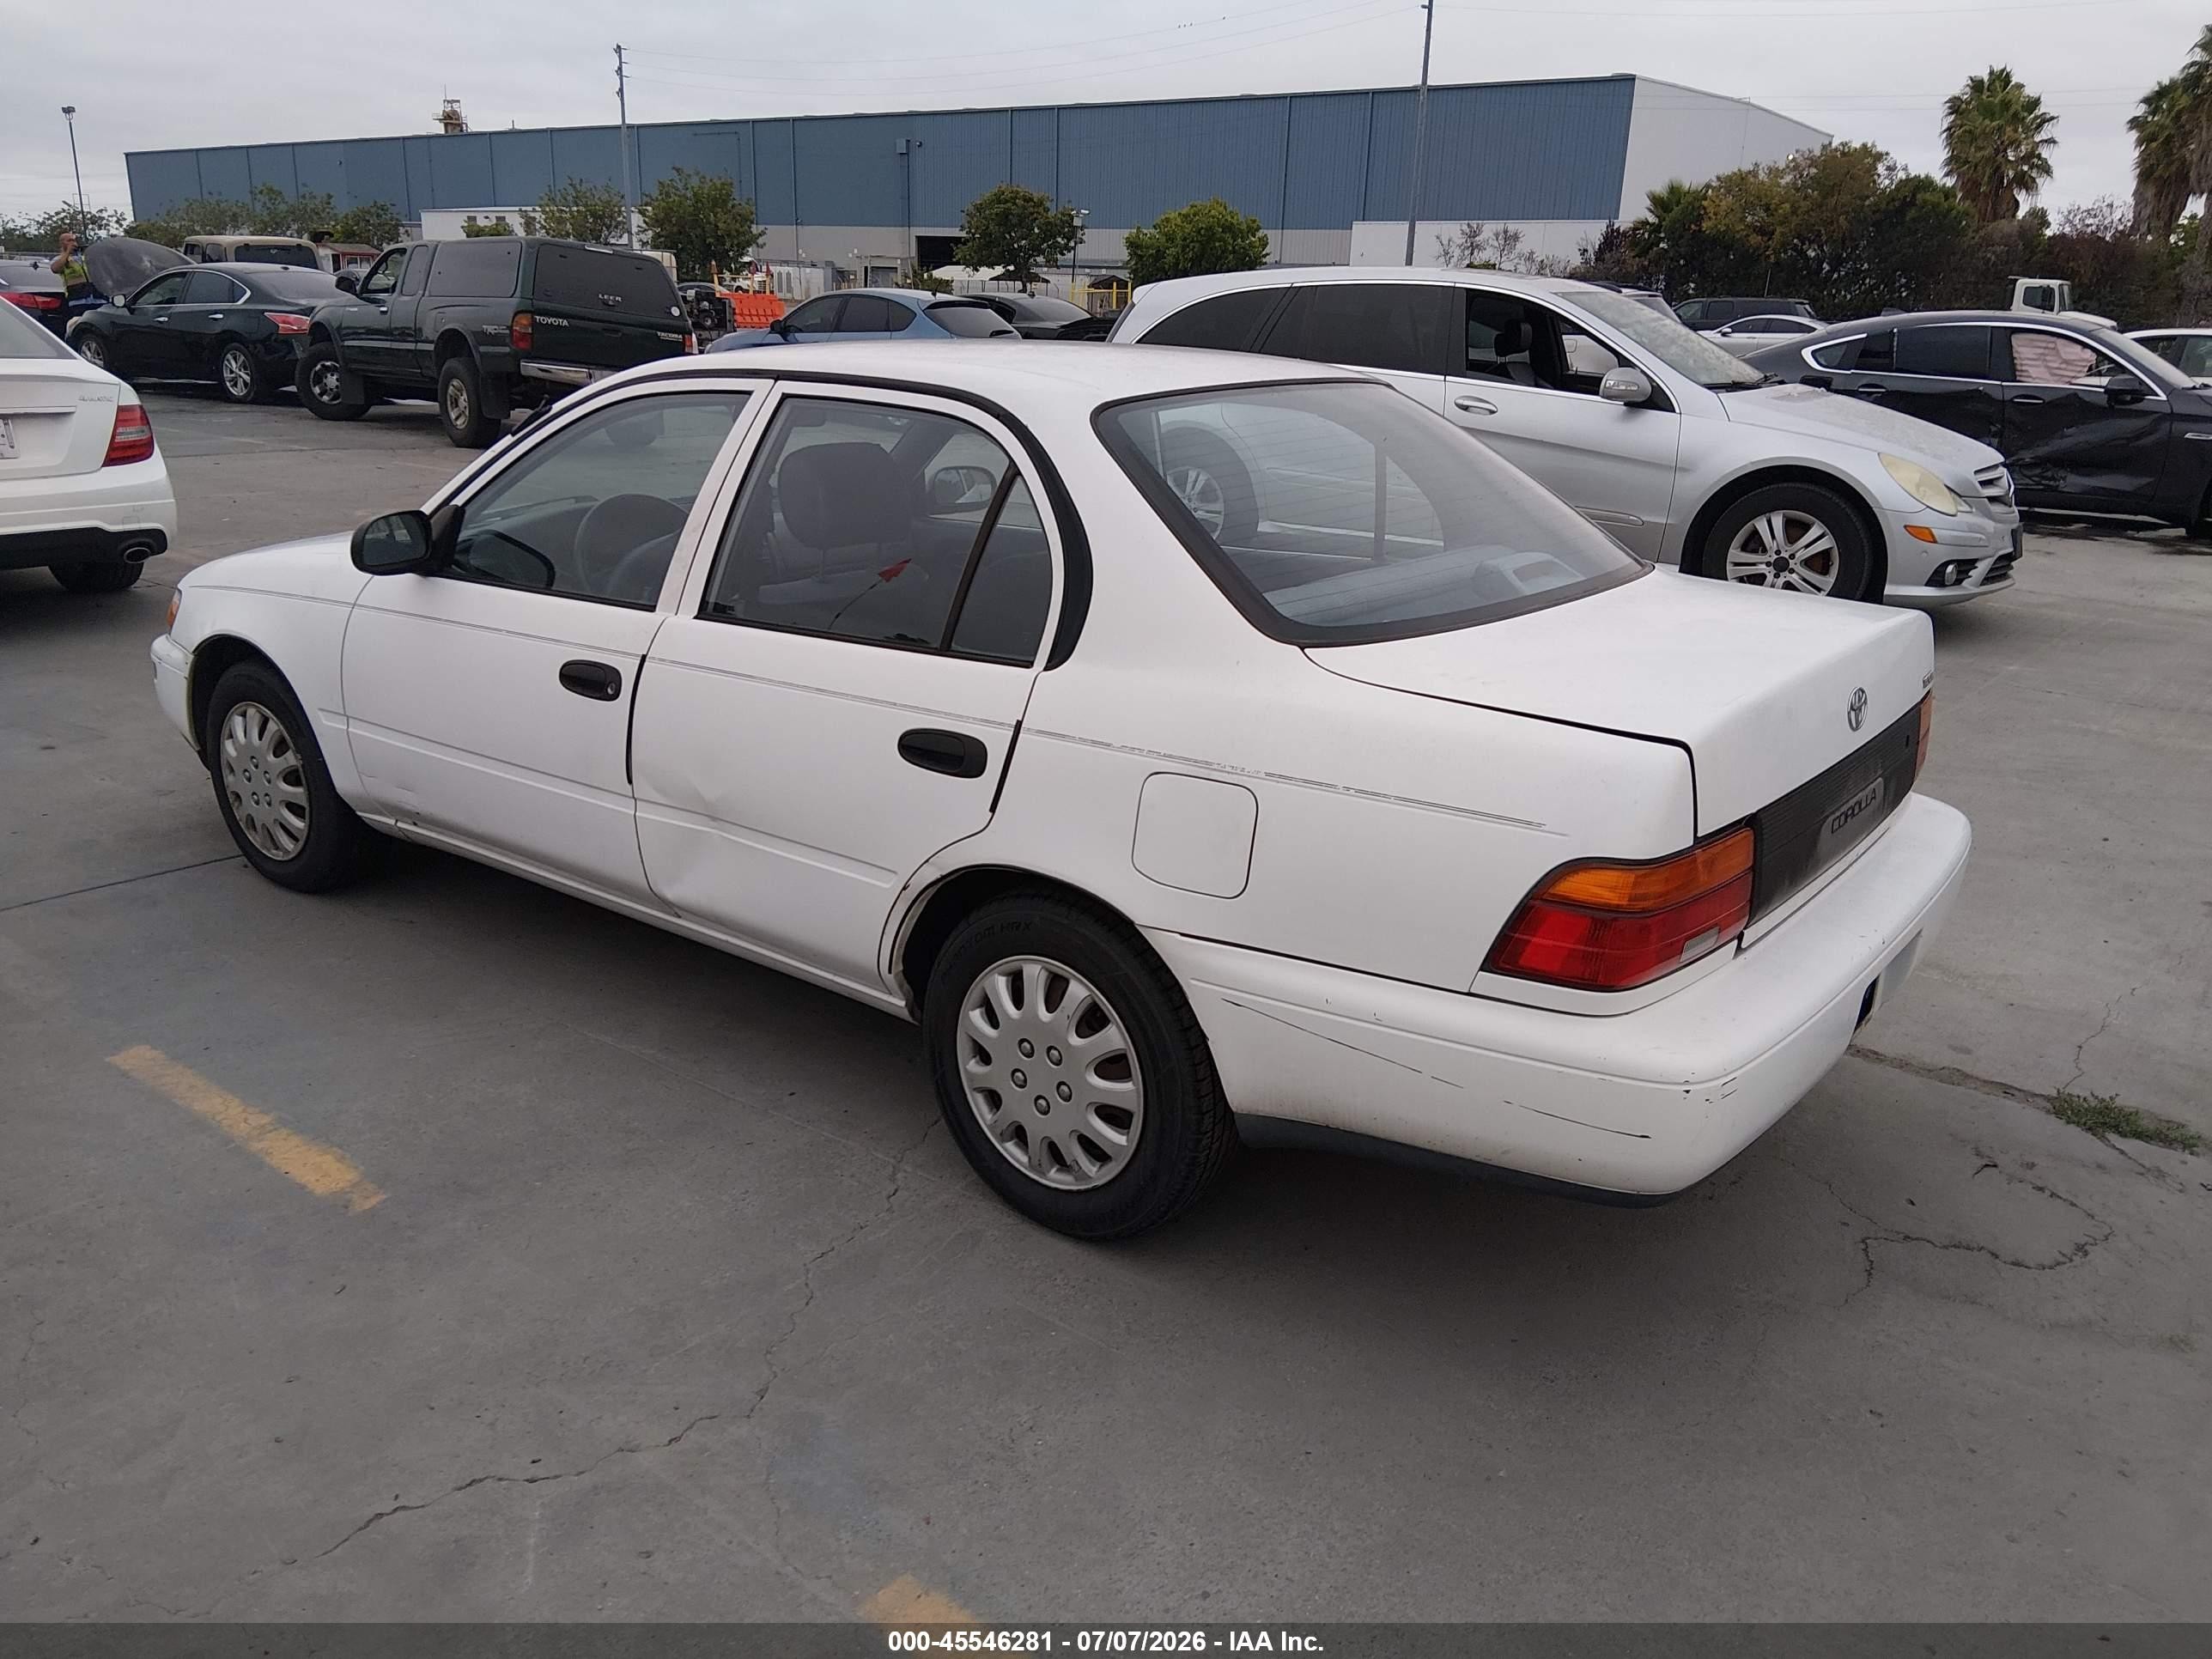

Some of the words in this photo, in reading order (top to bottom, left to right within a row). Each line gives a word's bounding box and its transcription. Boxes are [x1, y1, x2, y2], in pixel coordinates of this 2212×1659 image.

[599, 293, 623, 302] LEER
[534, 315, 568, 328] TOYOTA
[1831, 787, 1876, 835] COROLLA
